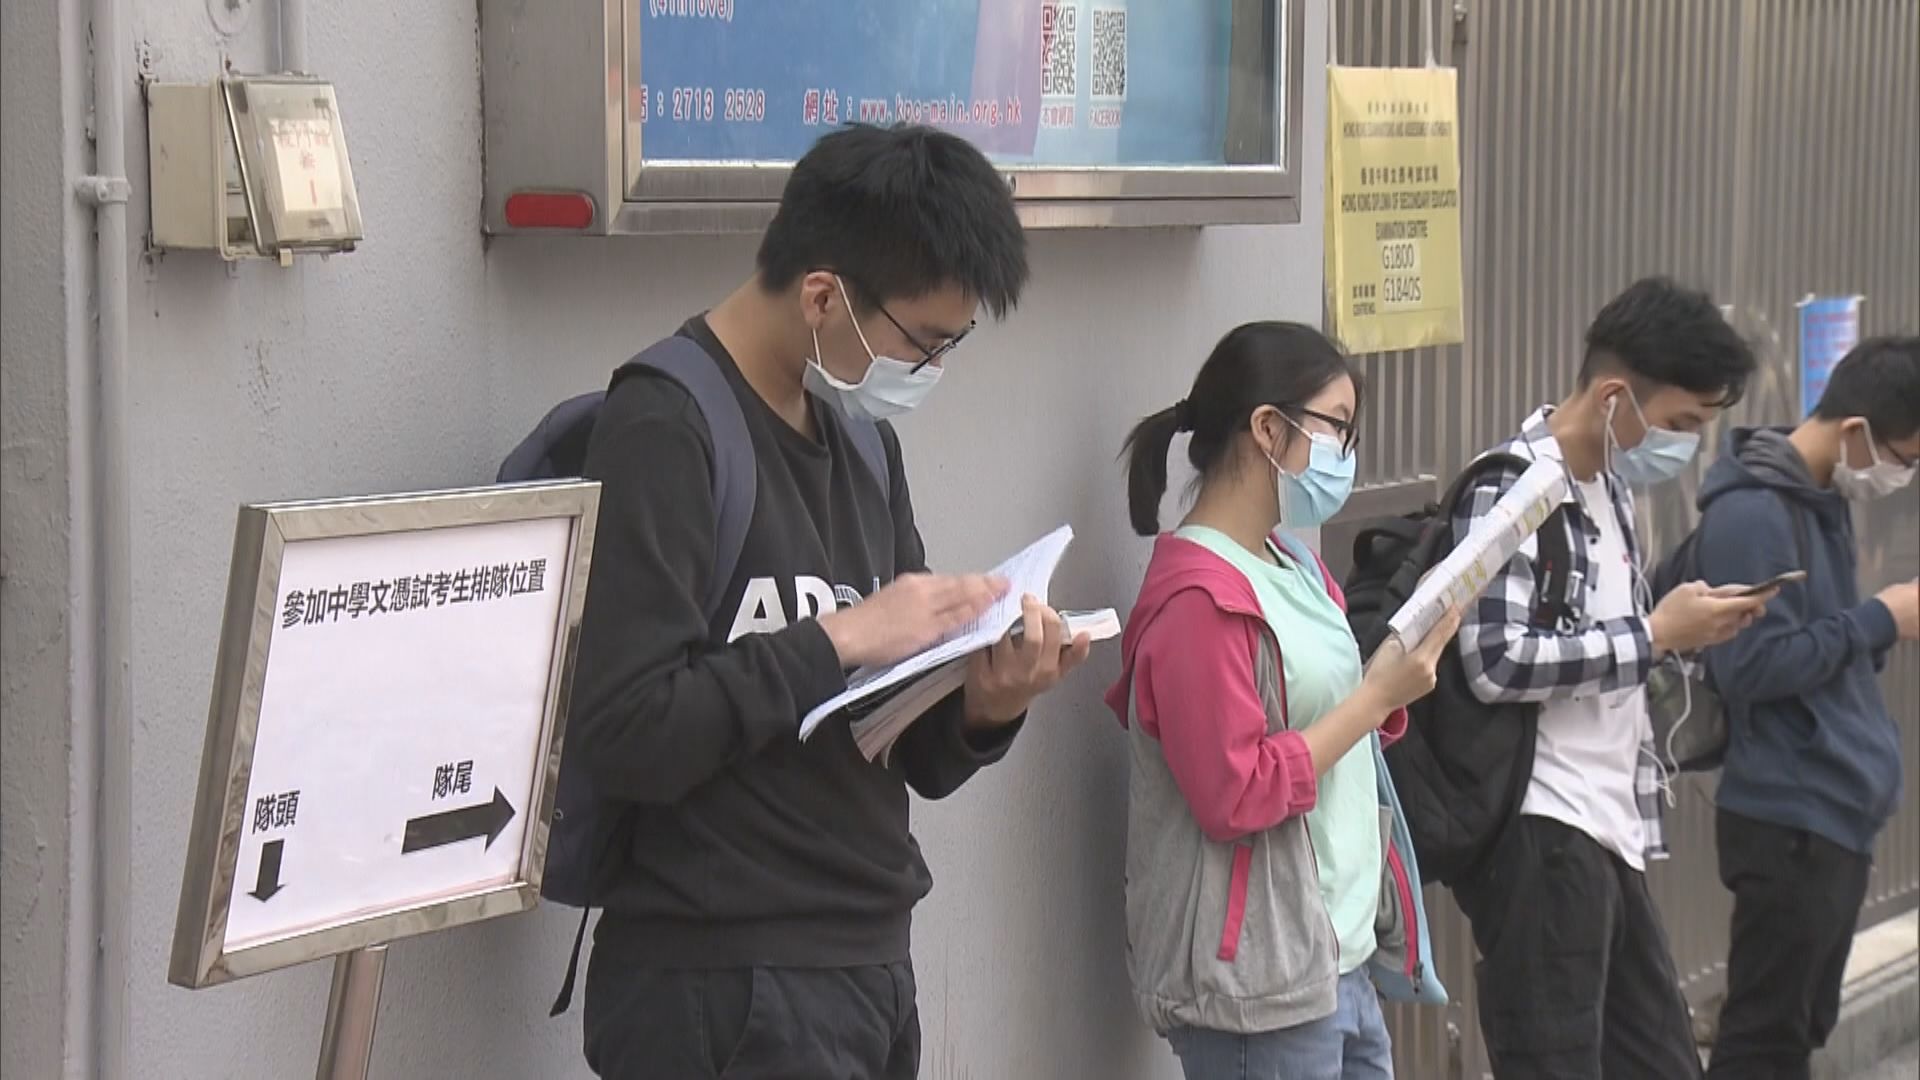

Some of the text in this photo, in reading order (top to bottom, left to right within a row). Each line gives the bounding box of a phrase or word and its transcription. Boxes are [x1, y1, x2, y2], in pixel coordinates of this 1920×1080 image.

[672, 86, 714, 121] 2713
[724, 87, 765, 121] 2528
[1383, 243, 1414, 269] G1800
[1384, 276, 1421, 302] G1840S
[282, 558, 547, 629] 參加中學文憑試考生排隊位置
[432, 760, 474, 800] 隊尾
[252, 790, 300, 834] 隊頭
